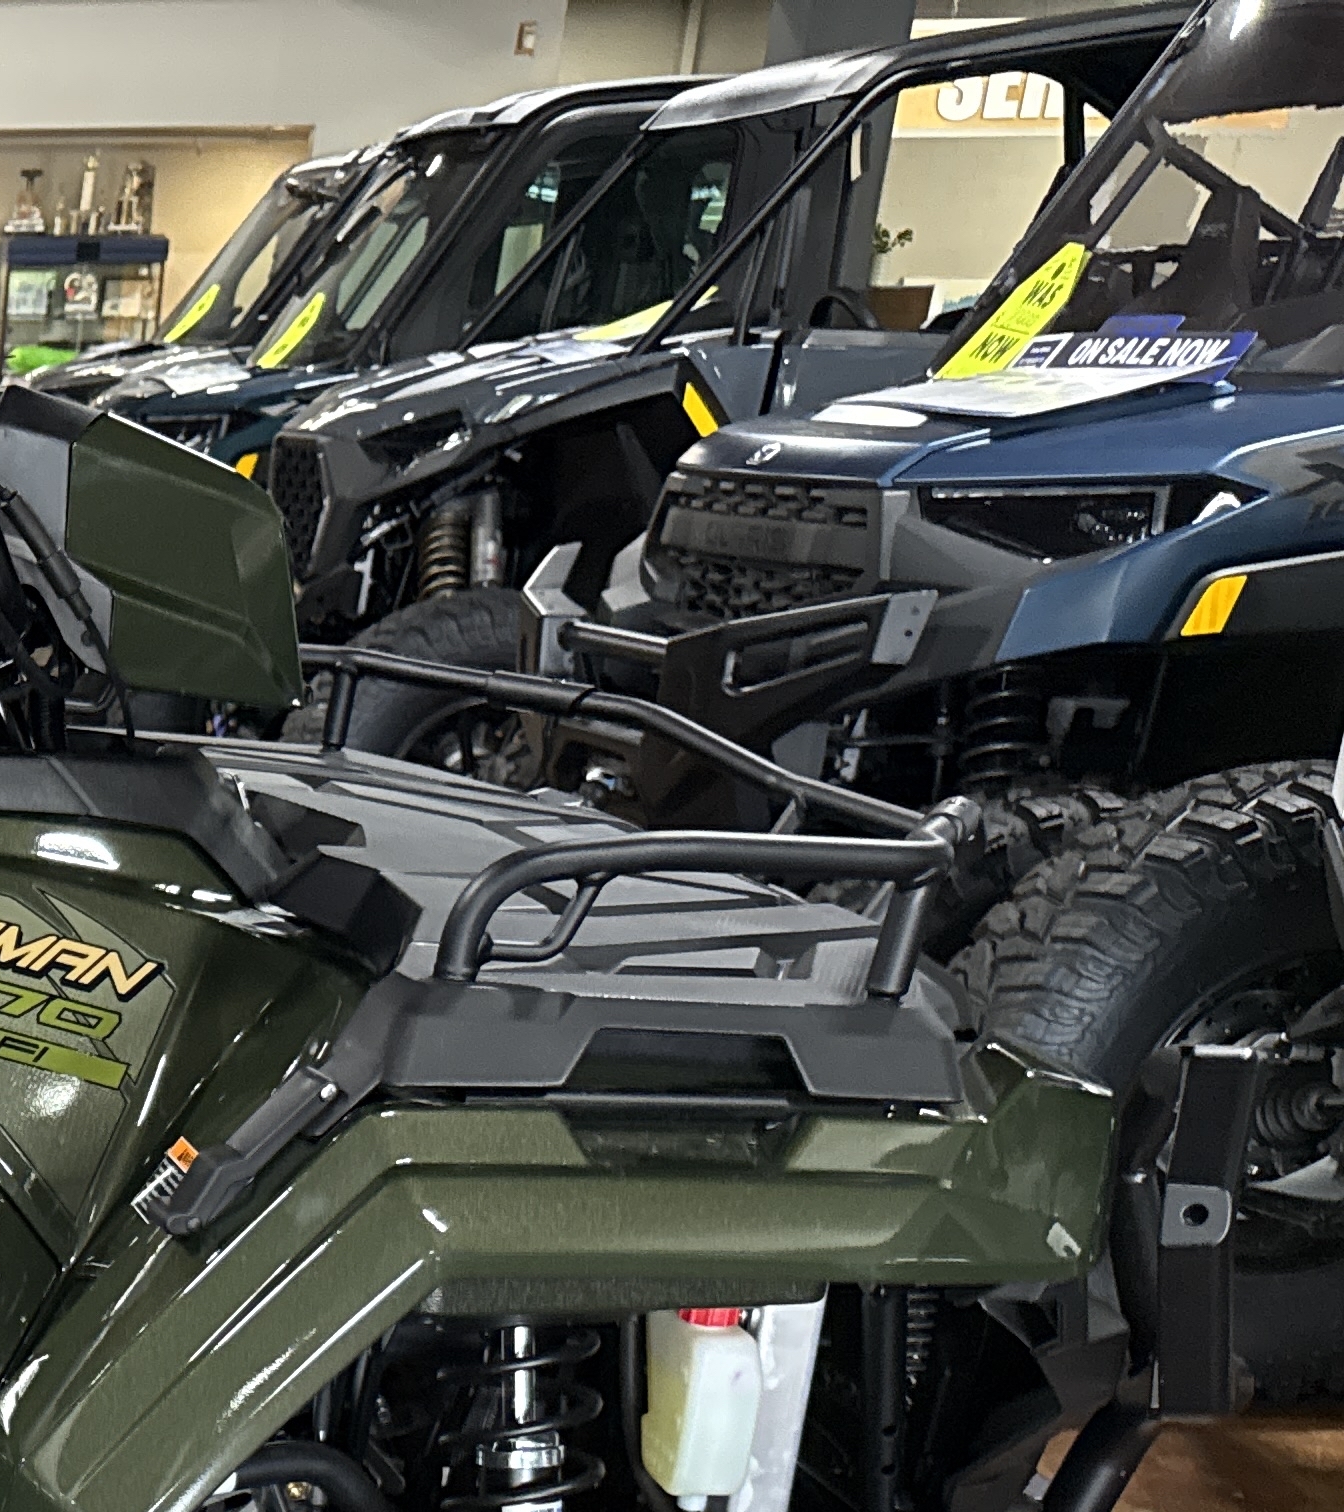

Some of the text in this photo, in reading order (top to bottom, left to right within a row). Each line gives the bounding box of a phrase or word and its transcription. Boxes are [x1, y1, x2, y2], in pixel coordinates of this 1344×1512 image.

[1022, 279, 1064, 309] WAS
[968, 331, 1021, 365] NOW
[1068, 338, 1105, 366] ON
[1100, 337, 1169, 365] SALE
[1158, 337, 1231, 367] NOW
